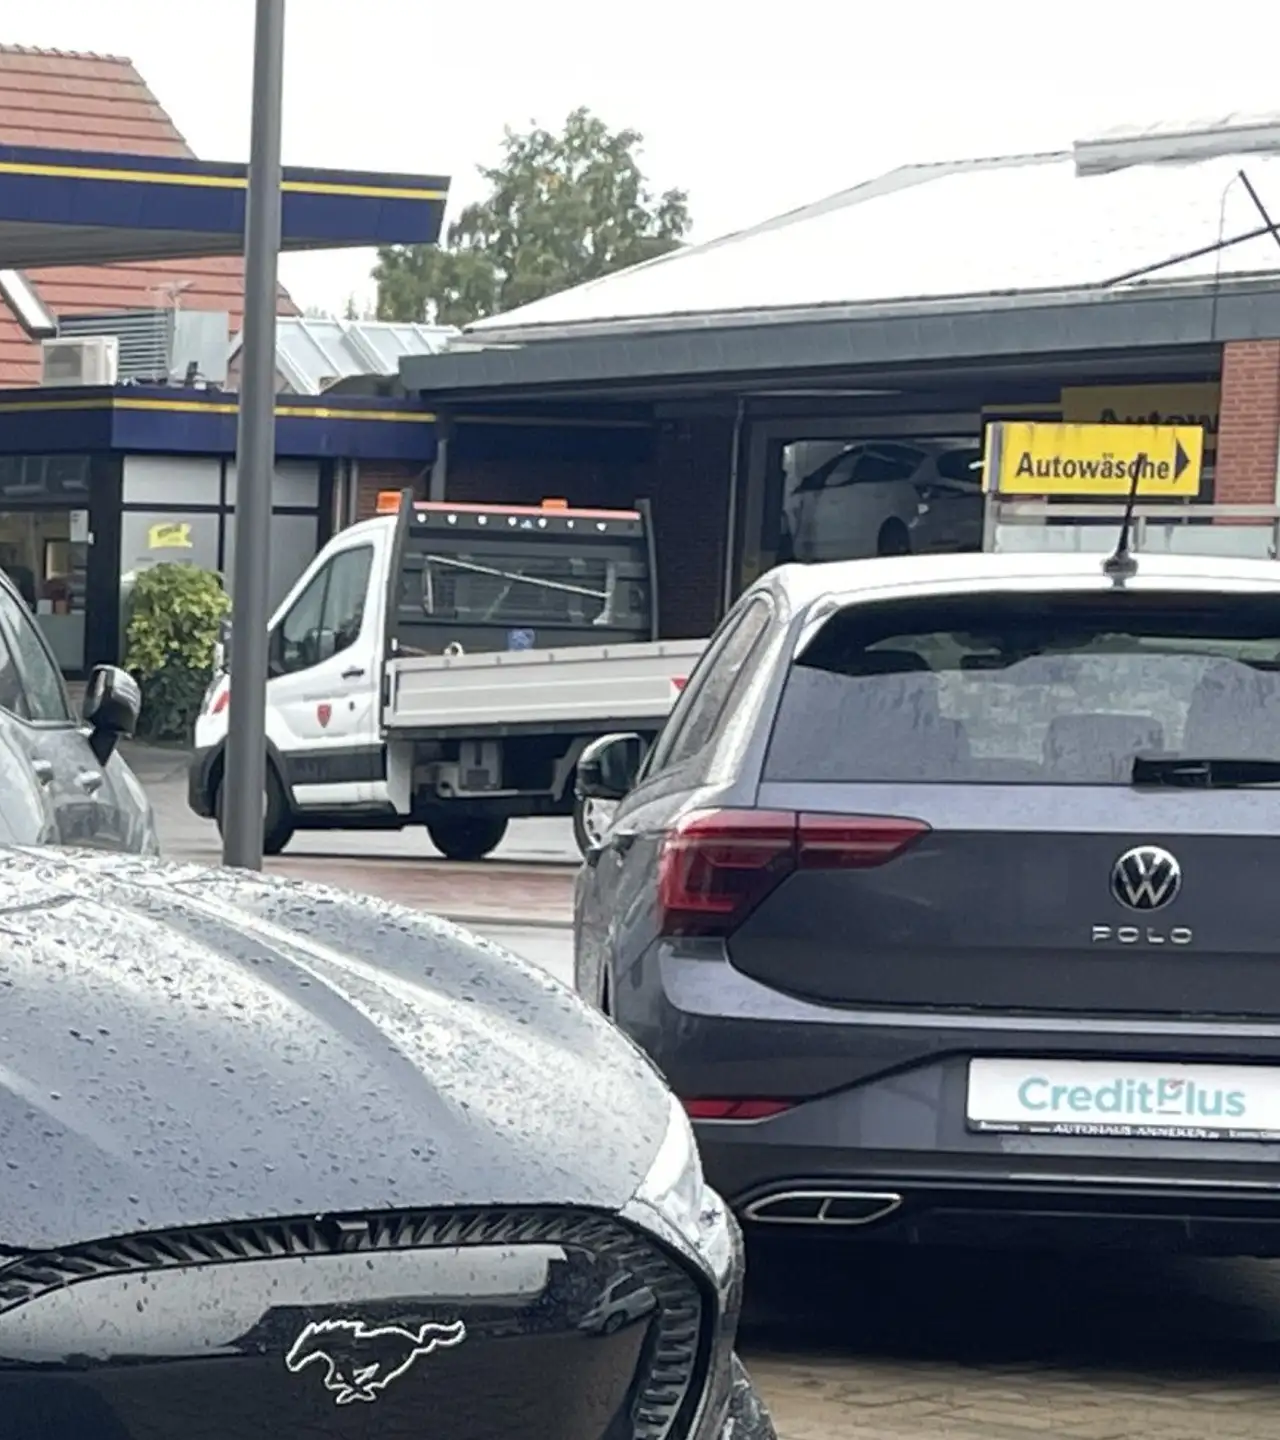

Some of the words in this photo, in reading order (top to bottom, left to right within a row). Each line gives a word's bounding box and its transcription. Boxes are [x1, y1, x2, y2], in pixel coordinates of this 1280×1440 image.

[1015, 451, 1170, 481] Autowäsche
[1092, 925, 1192, 944] POLO
[1017, 1076, 1247, 1117] CreditPlus
